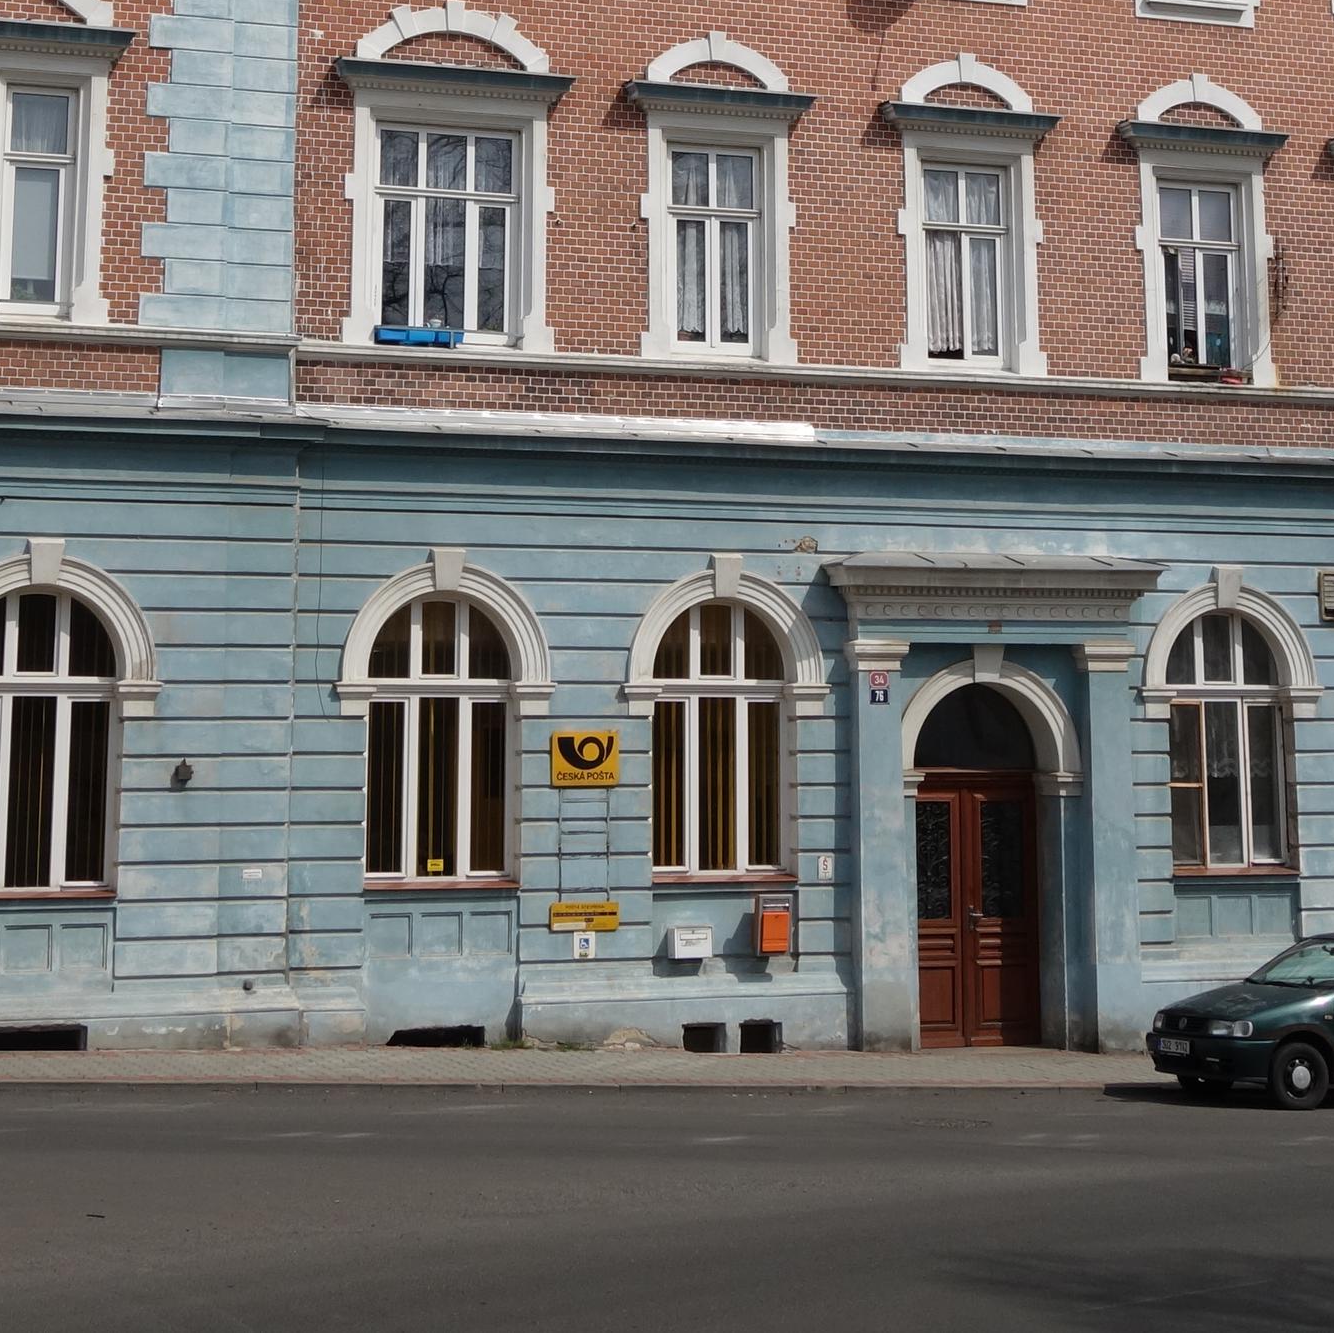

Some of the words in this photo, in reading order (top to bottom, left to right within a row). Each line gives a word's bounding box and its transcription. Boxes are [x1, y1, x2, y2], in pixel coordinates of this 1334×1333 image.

[874, 675, 885, 684] 34
[875, 690, 884, 702] 76
[556, 770, 585, 781] ČESKÁ
[587, 770, 615, 780] POŠTA
